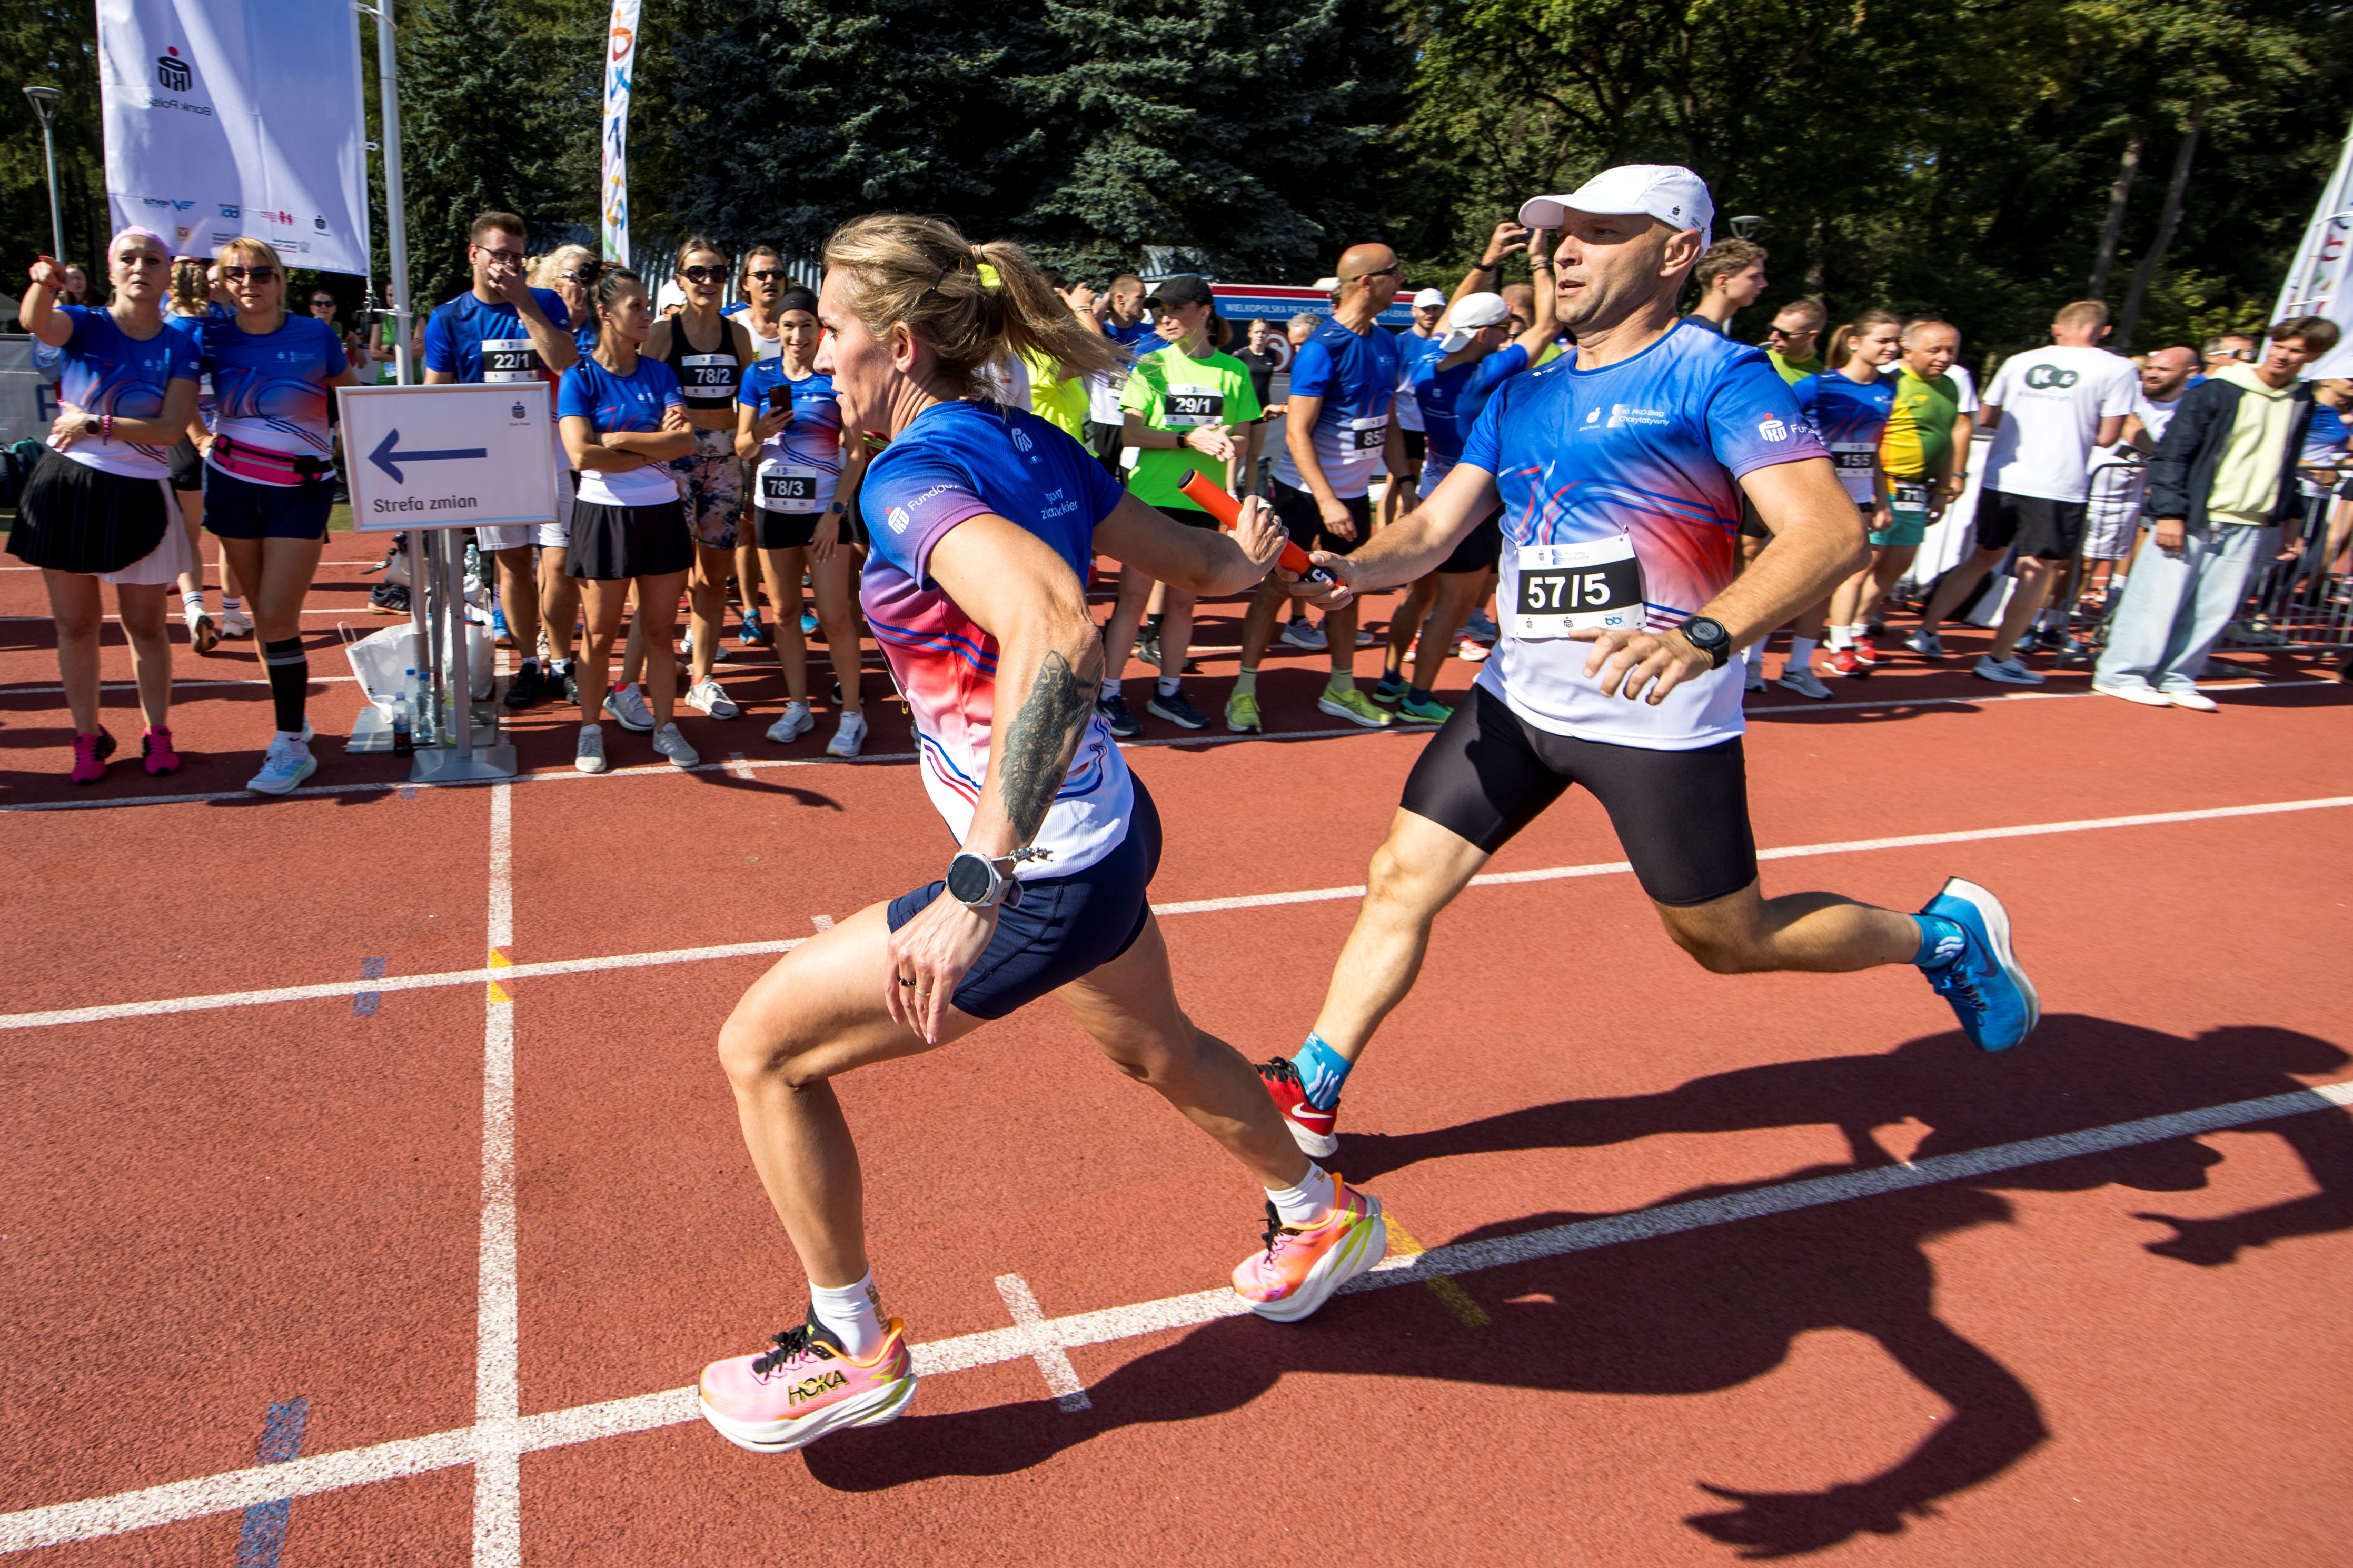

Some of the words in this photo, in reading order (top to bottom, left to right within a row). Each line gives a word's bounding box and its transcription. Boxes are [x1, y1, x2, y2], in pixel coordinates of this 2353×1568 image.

[1225, 304, 1287, 313] WIELKOPOLSKA
[493, 353, 530, 369] 22/1
[694, 368, 731, 384] 78/2
[1174, 397, 1212, 413] 29/1
[1618, 416, 1670, 426] Charytatywny
[1647, 410, 1665, 418] Bieg
[769, 480, 805, 496] 78/3
[373, 496, 424, 513] Strefa
[429, 495, 478, 510] zmian
[1528, 572, 1611, 609] 57/5
[788, 1370, 850, 1407] HOKA
